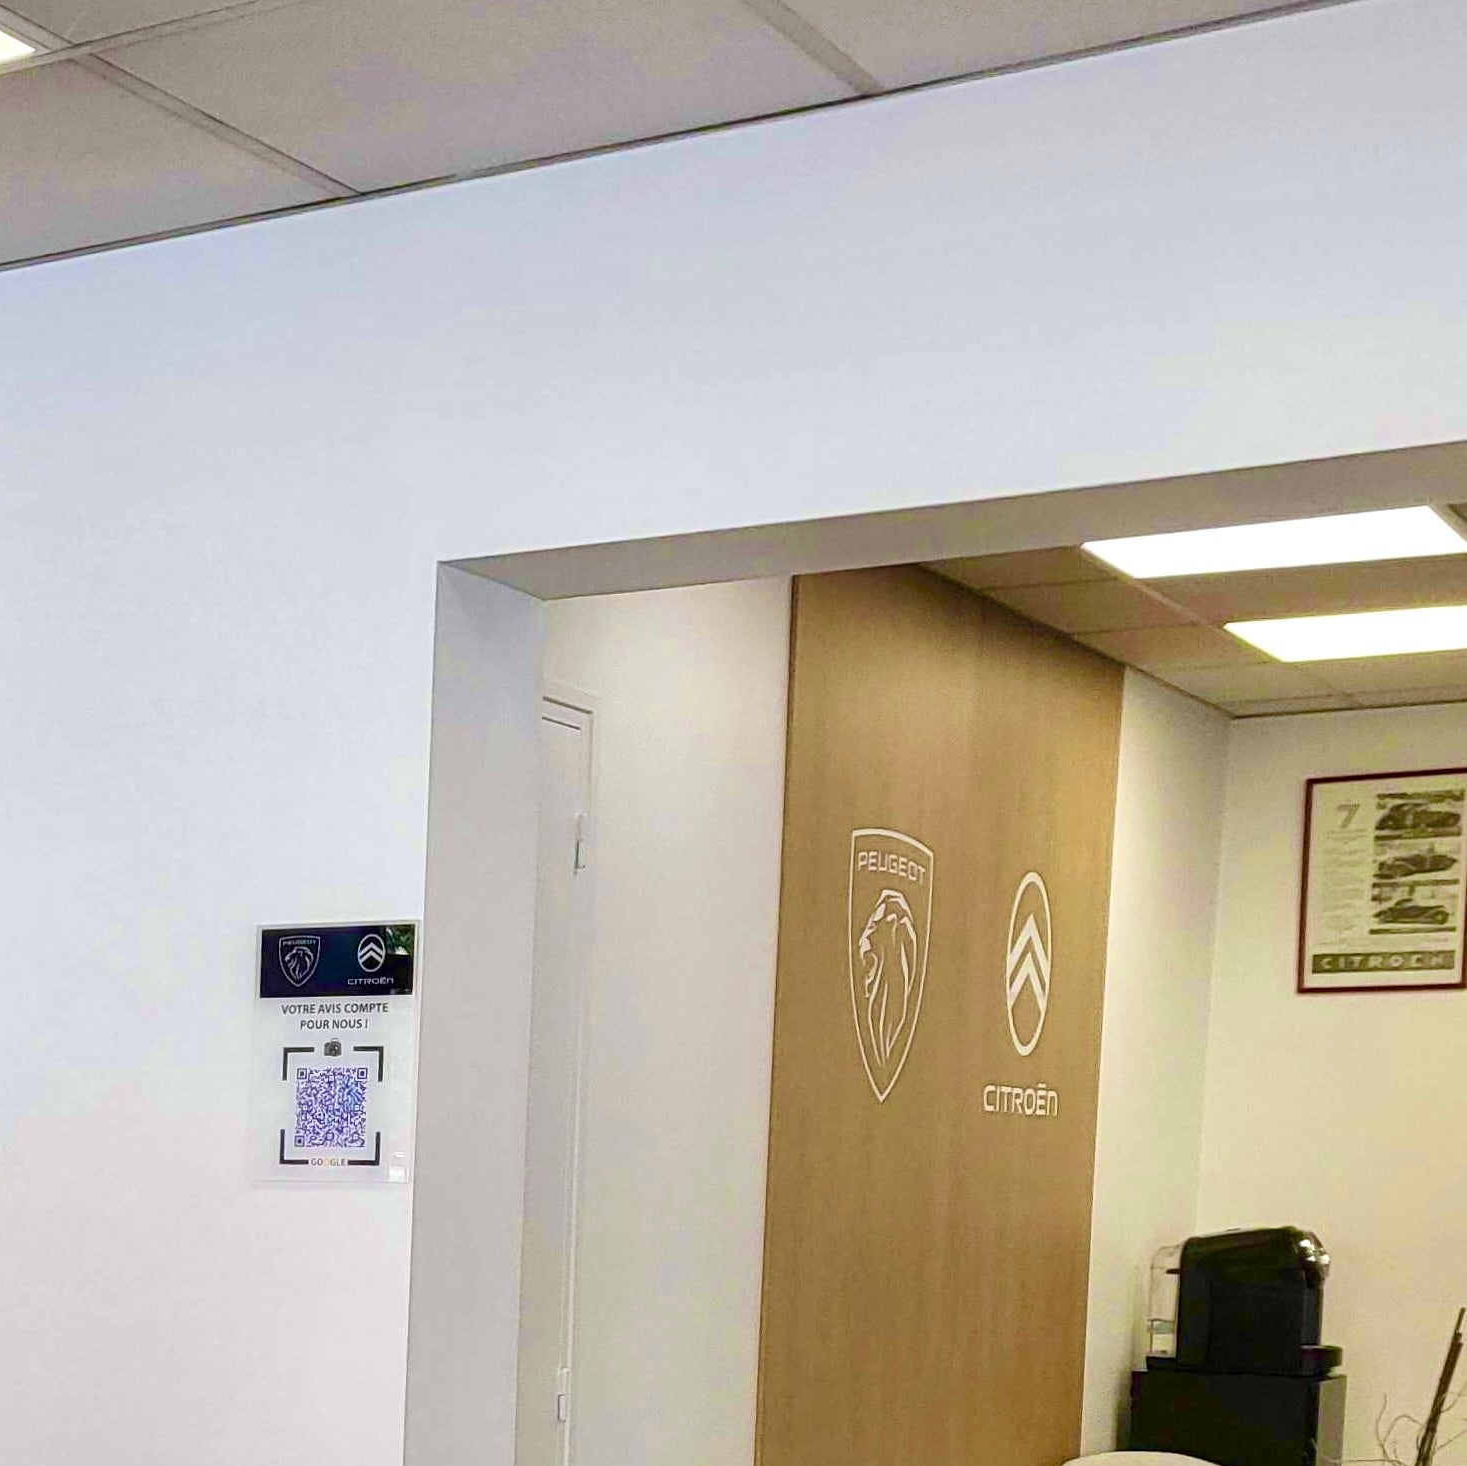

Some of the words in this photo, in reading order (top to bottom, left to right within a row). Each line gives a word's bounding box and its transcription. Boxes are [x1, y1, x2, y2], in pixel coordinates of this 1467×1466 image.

[857, 851, 926, 886] PEUGEOT
[282, 1003, 315, 1014] VOTRE
[318, 1003, 342, 1014] AVIS
[344, 1002, 389, 1013] COMPTE
[300, 1019, 330, 1029] POUR
[332, 1018, 363, 1029] NOUS
